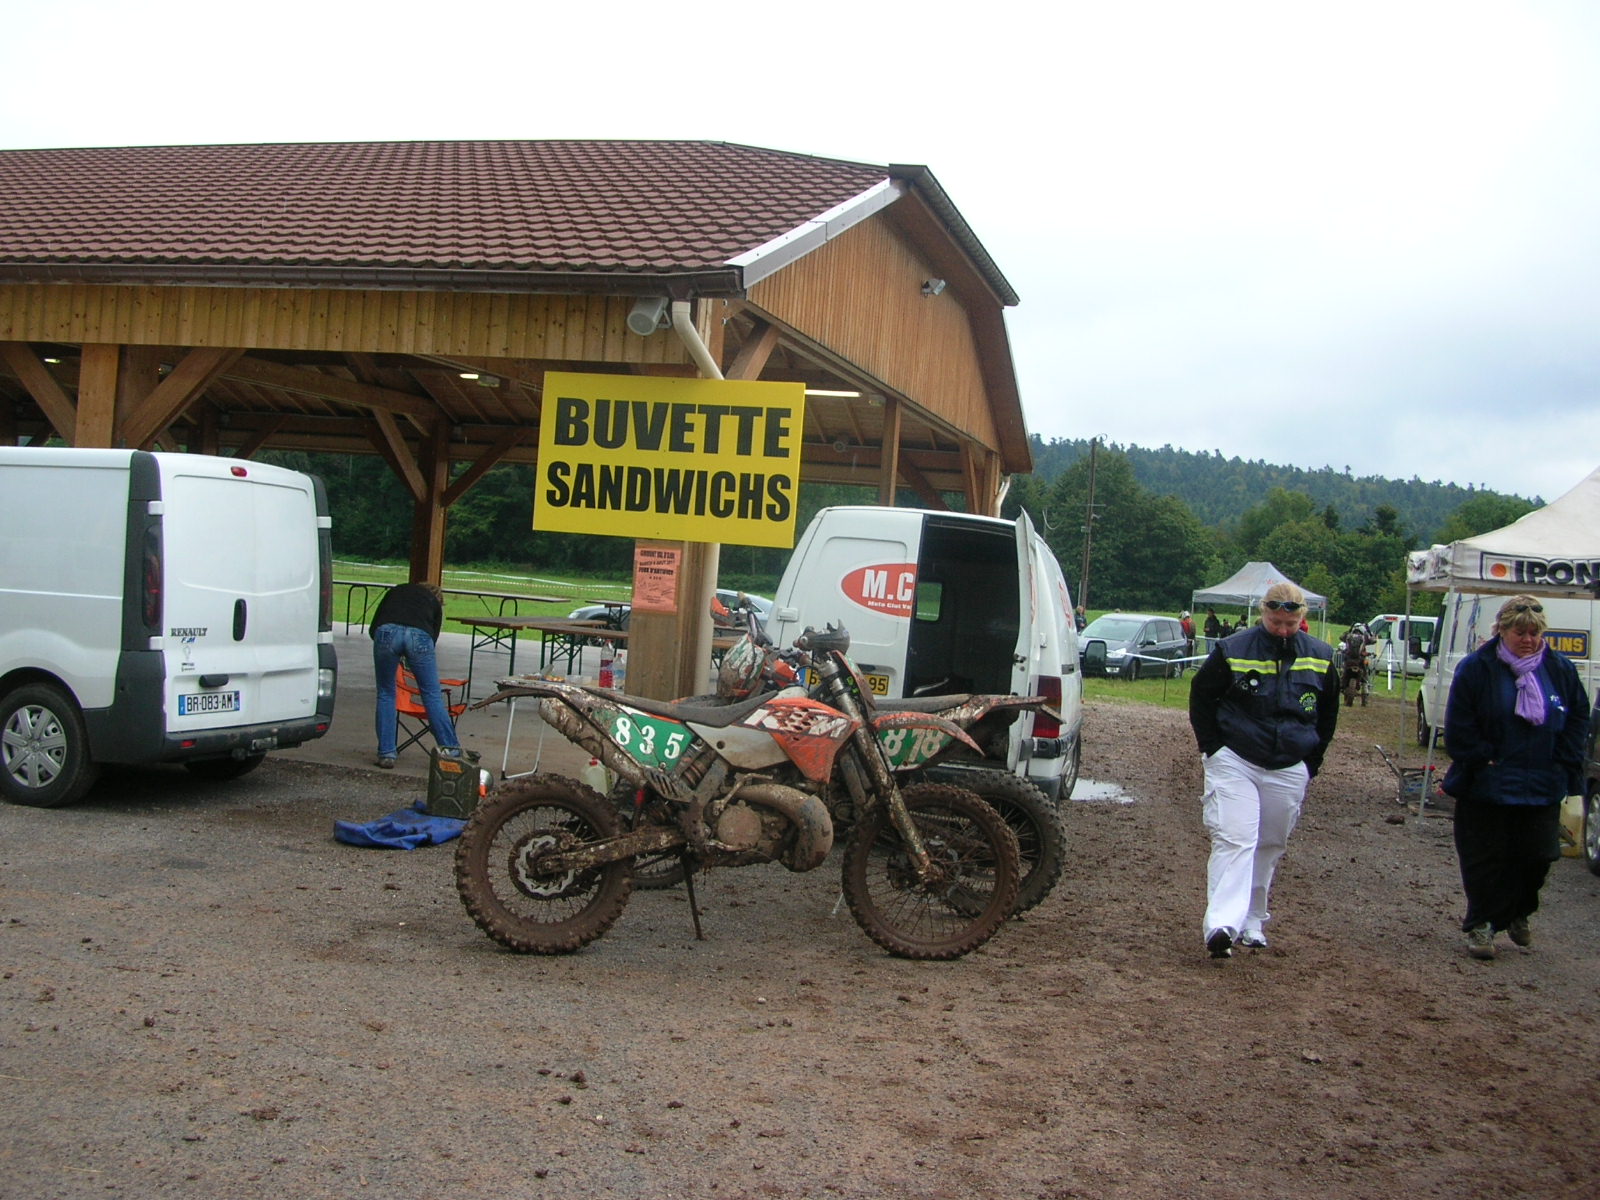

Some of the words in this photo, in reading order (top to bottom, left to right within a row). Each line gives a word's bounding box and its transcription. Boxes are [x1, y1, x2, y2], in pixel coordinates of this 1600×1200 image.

[554, 397, 792, 458] BUVETTE
[546, 461, 792, 522] SANDWICHS
[170, 627, 208, 637] RENAULT
[186, 693, 233, 712] BR-083-AM
[615, 716, 685, 760] 835
